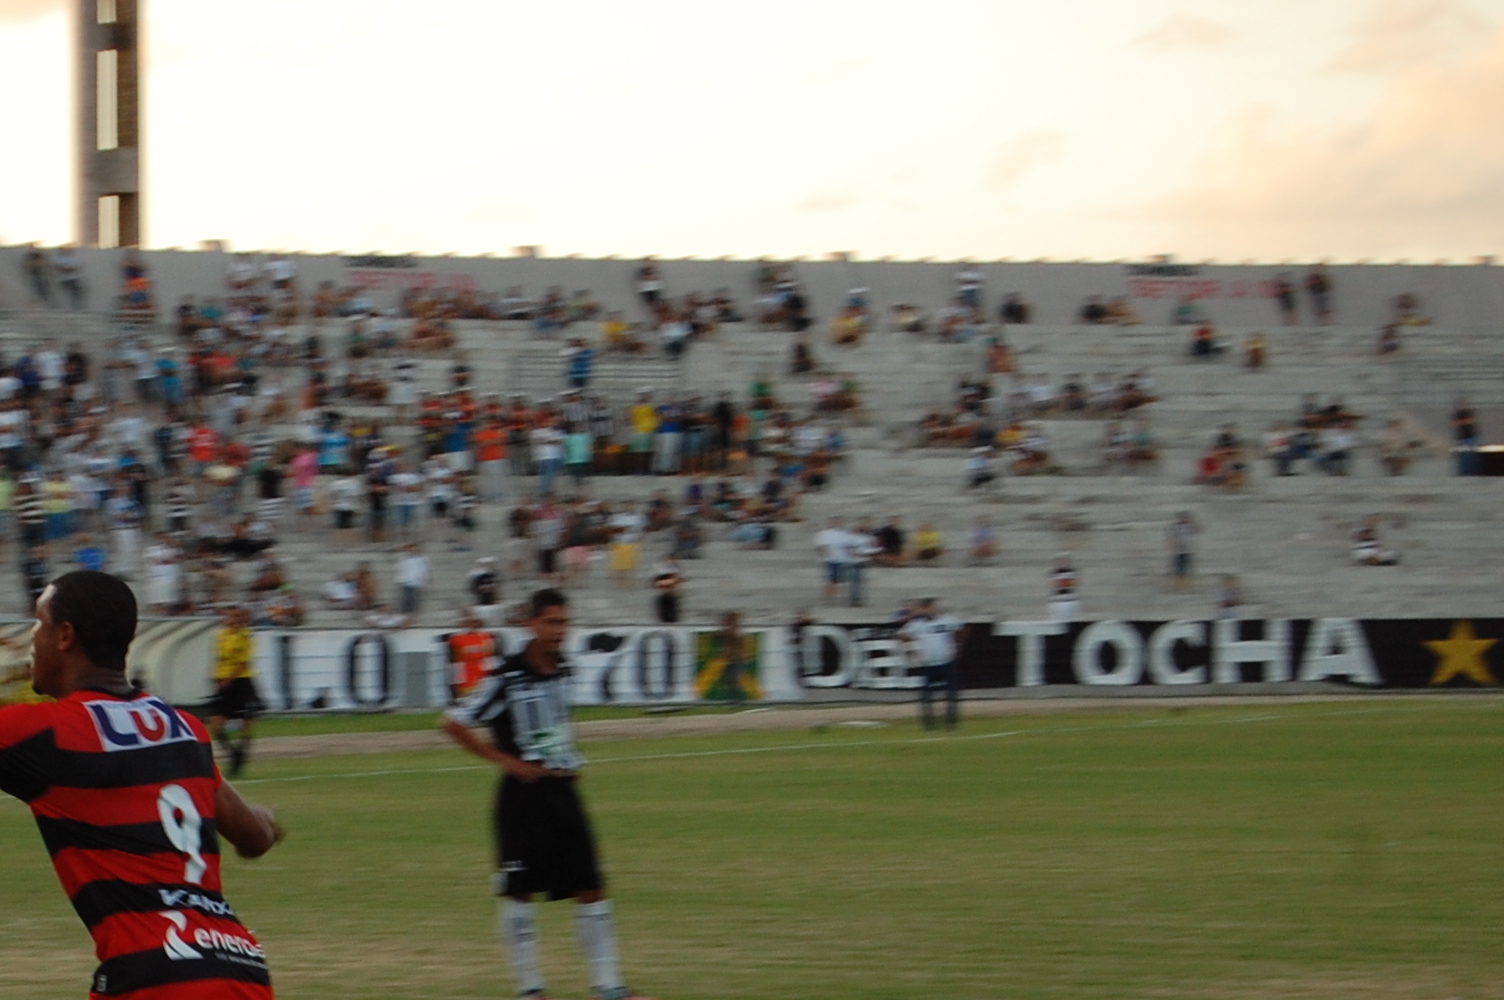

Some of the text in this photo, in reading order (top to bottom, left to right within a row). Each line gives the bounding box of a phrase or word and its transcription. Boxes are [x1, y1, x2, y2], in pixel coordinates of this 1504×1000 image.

[992, 617, 1385, 687] TOCHA
[89, 699, 194, 747] LUX
[156, 783, 208, 885] 9
